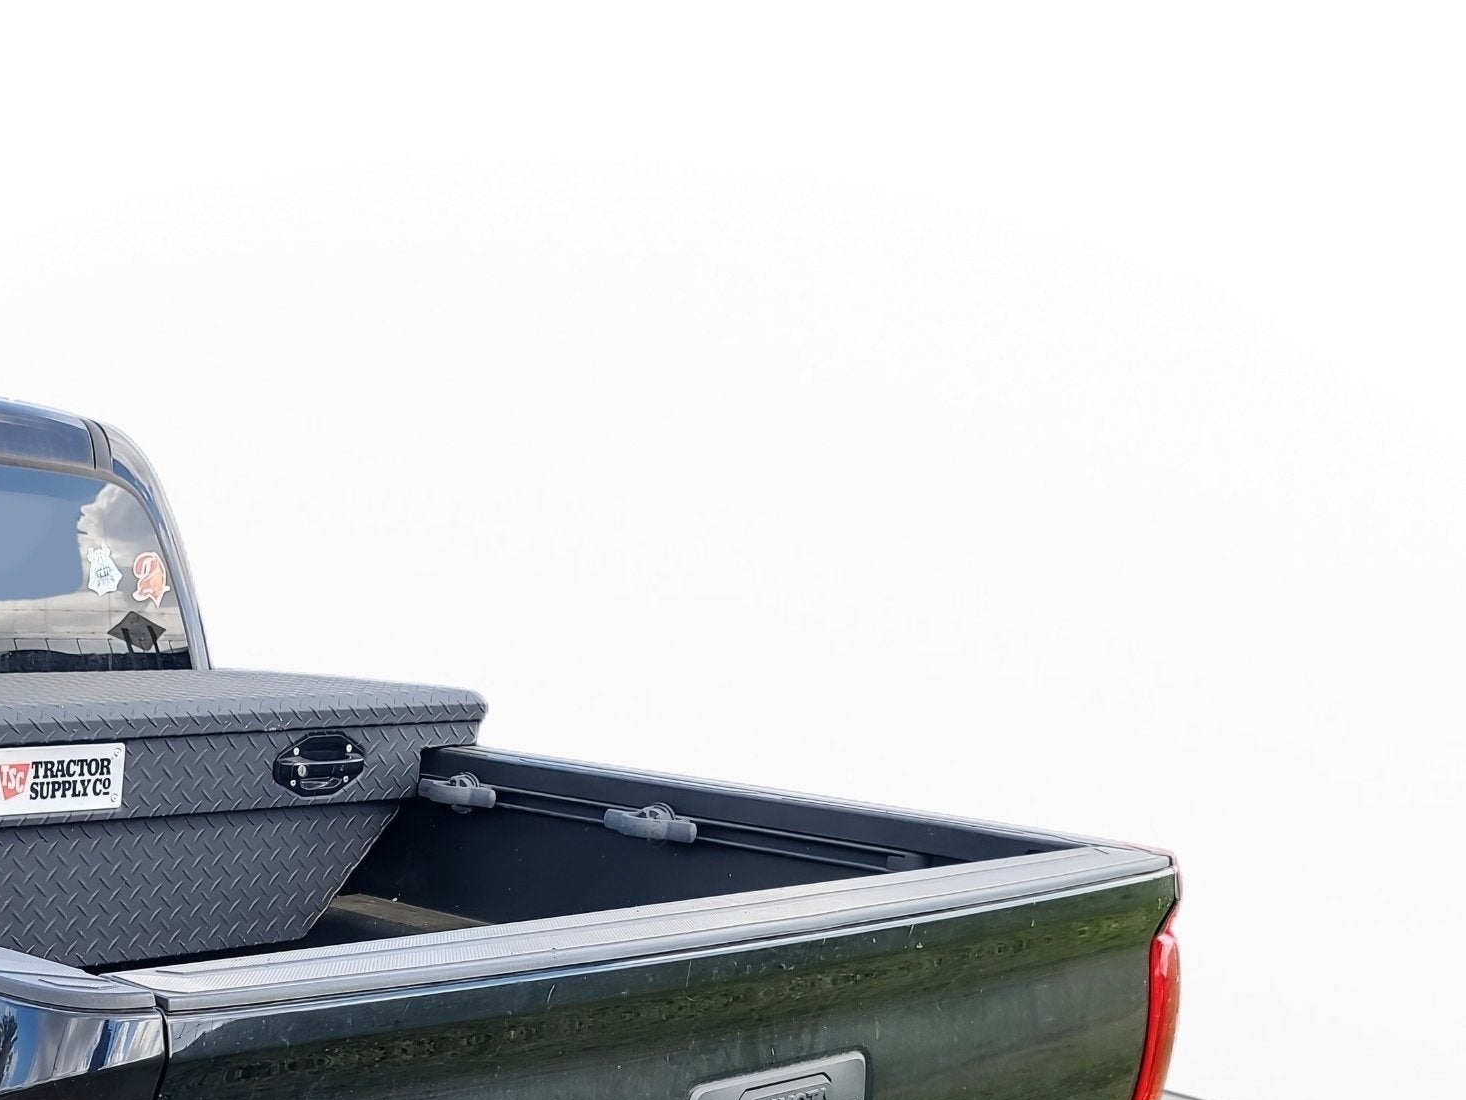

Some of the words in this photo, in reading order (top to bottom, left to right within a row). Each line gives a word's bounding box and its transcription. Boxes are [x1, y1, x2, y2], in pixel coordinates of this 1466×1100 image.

[0, 764, 25, 793] TSC
[31, 757, 111, 779] TRACTOR
[29, 778, 91, 800] SUPPLY
